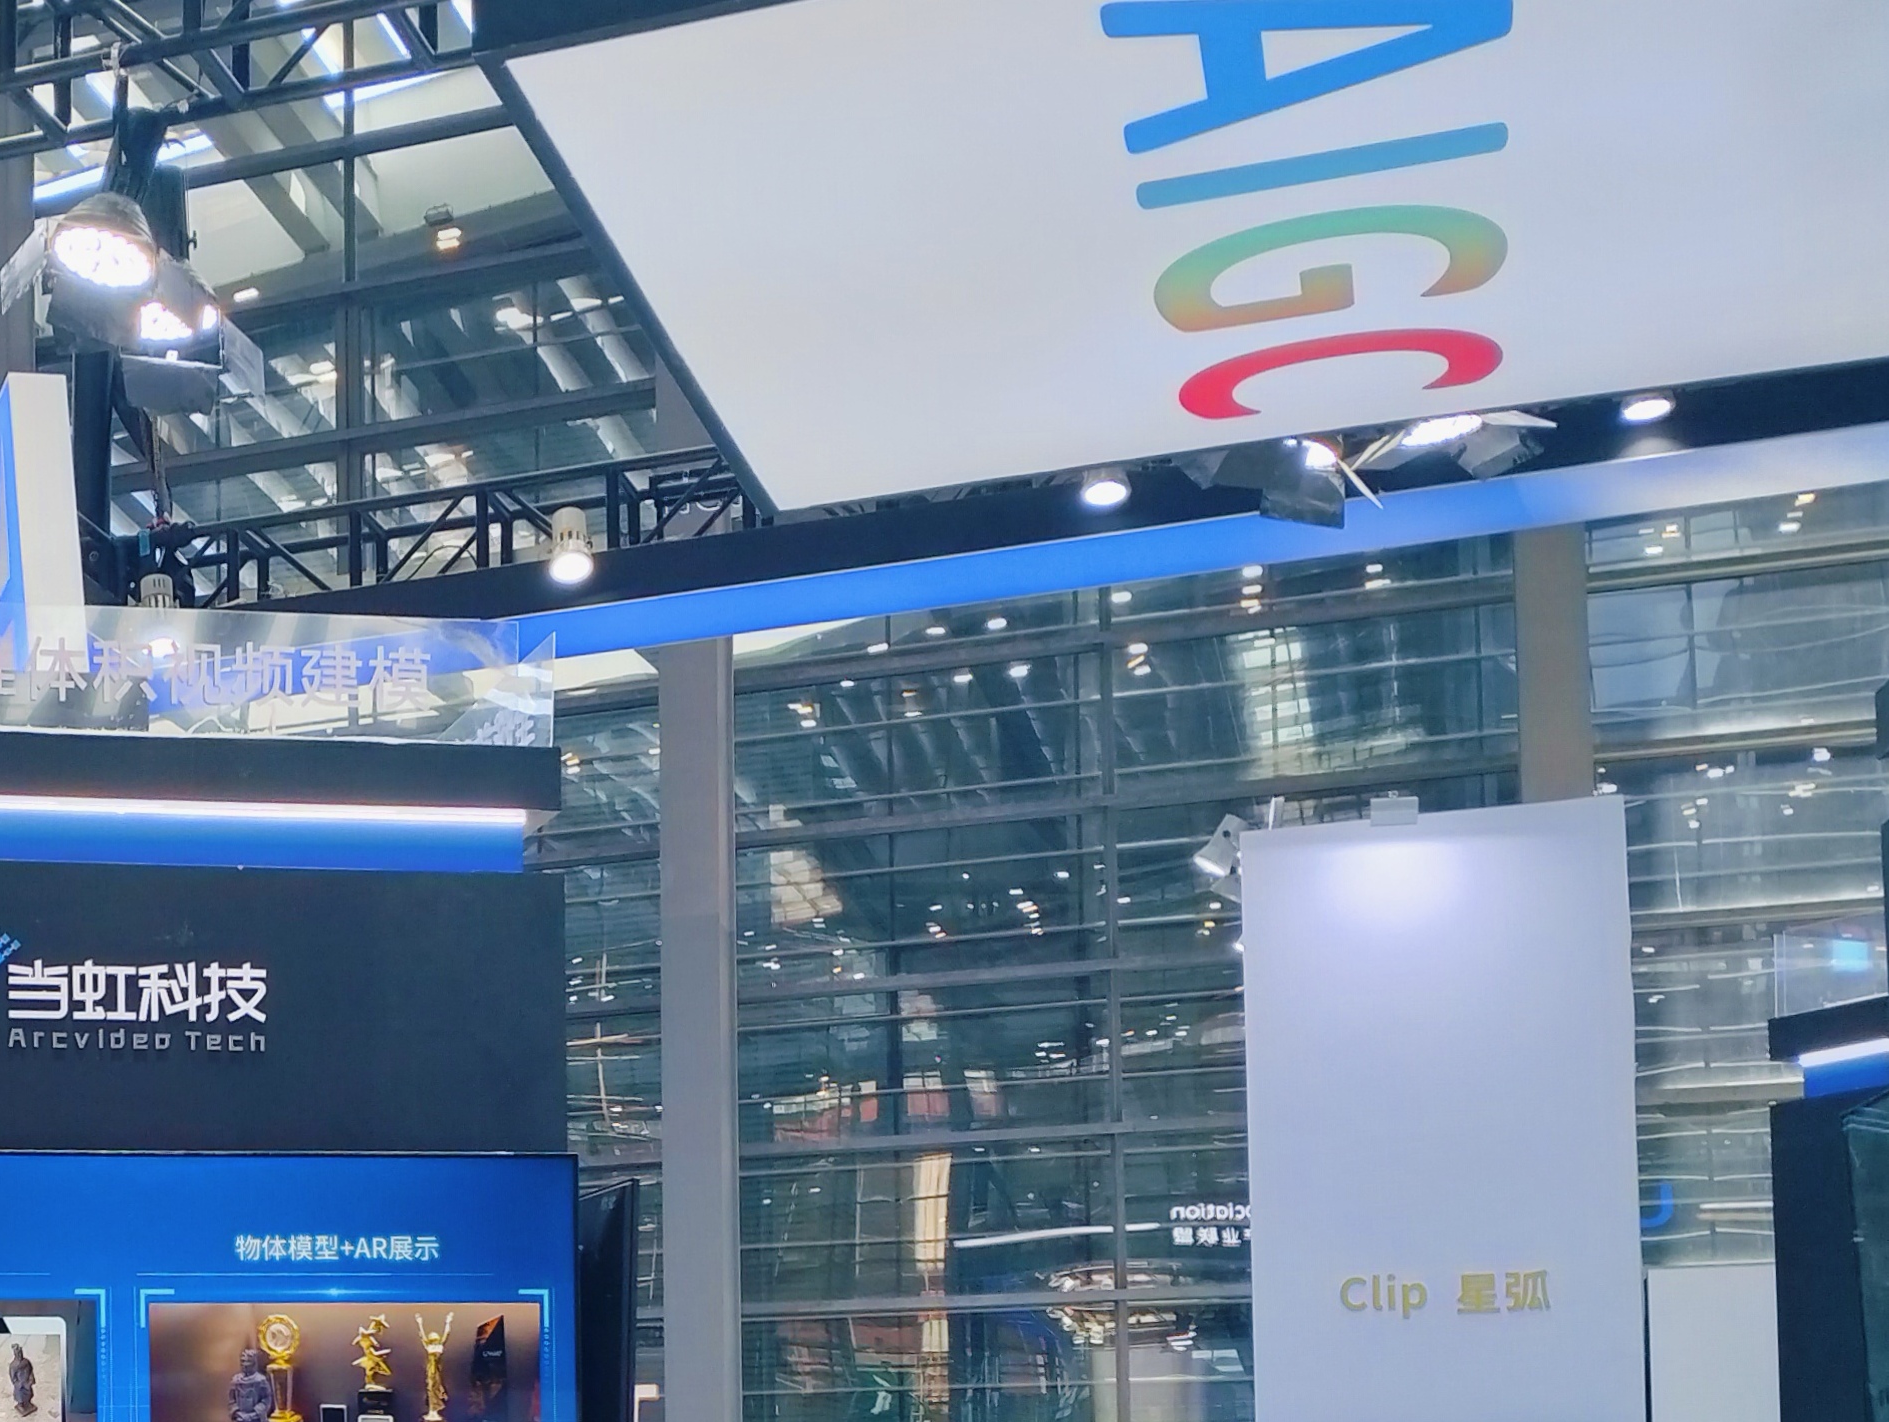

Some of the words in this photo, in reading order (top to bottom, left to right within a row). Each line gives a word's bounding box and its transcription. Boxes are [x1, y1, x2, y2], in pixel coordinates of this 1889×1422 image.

[1099, 0, 1512, 420] AIGC
[7, 959, 267, 1024] 当虹科技
[185, 1031, 266, 1052] Tech
[235, 1234, 440, 1262] 物体模型+AR展示
[1340, 1274, 1428, 1320] Clip
[1457, 1269, 1551, 1315] 星弧
